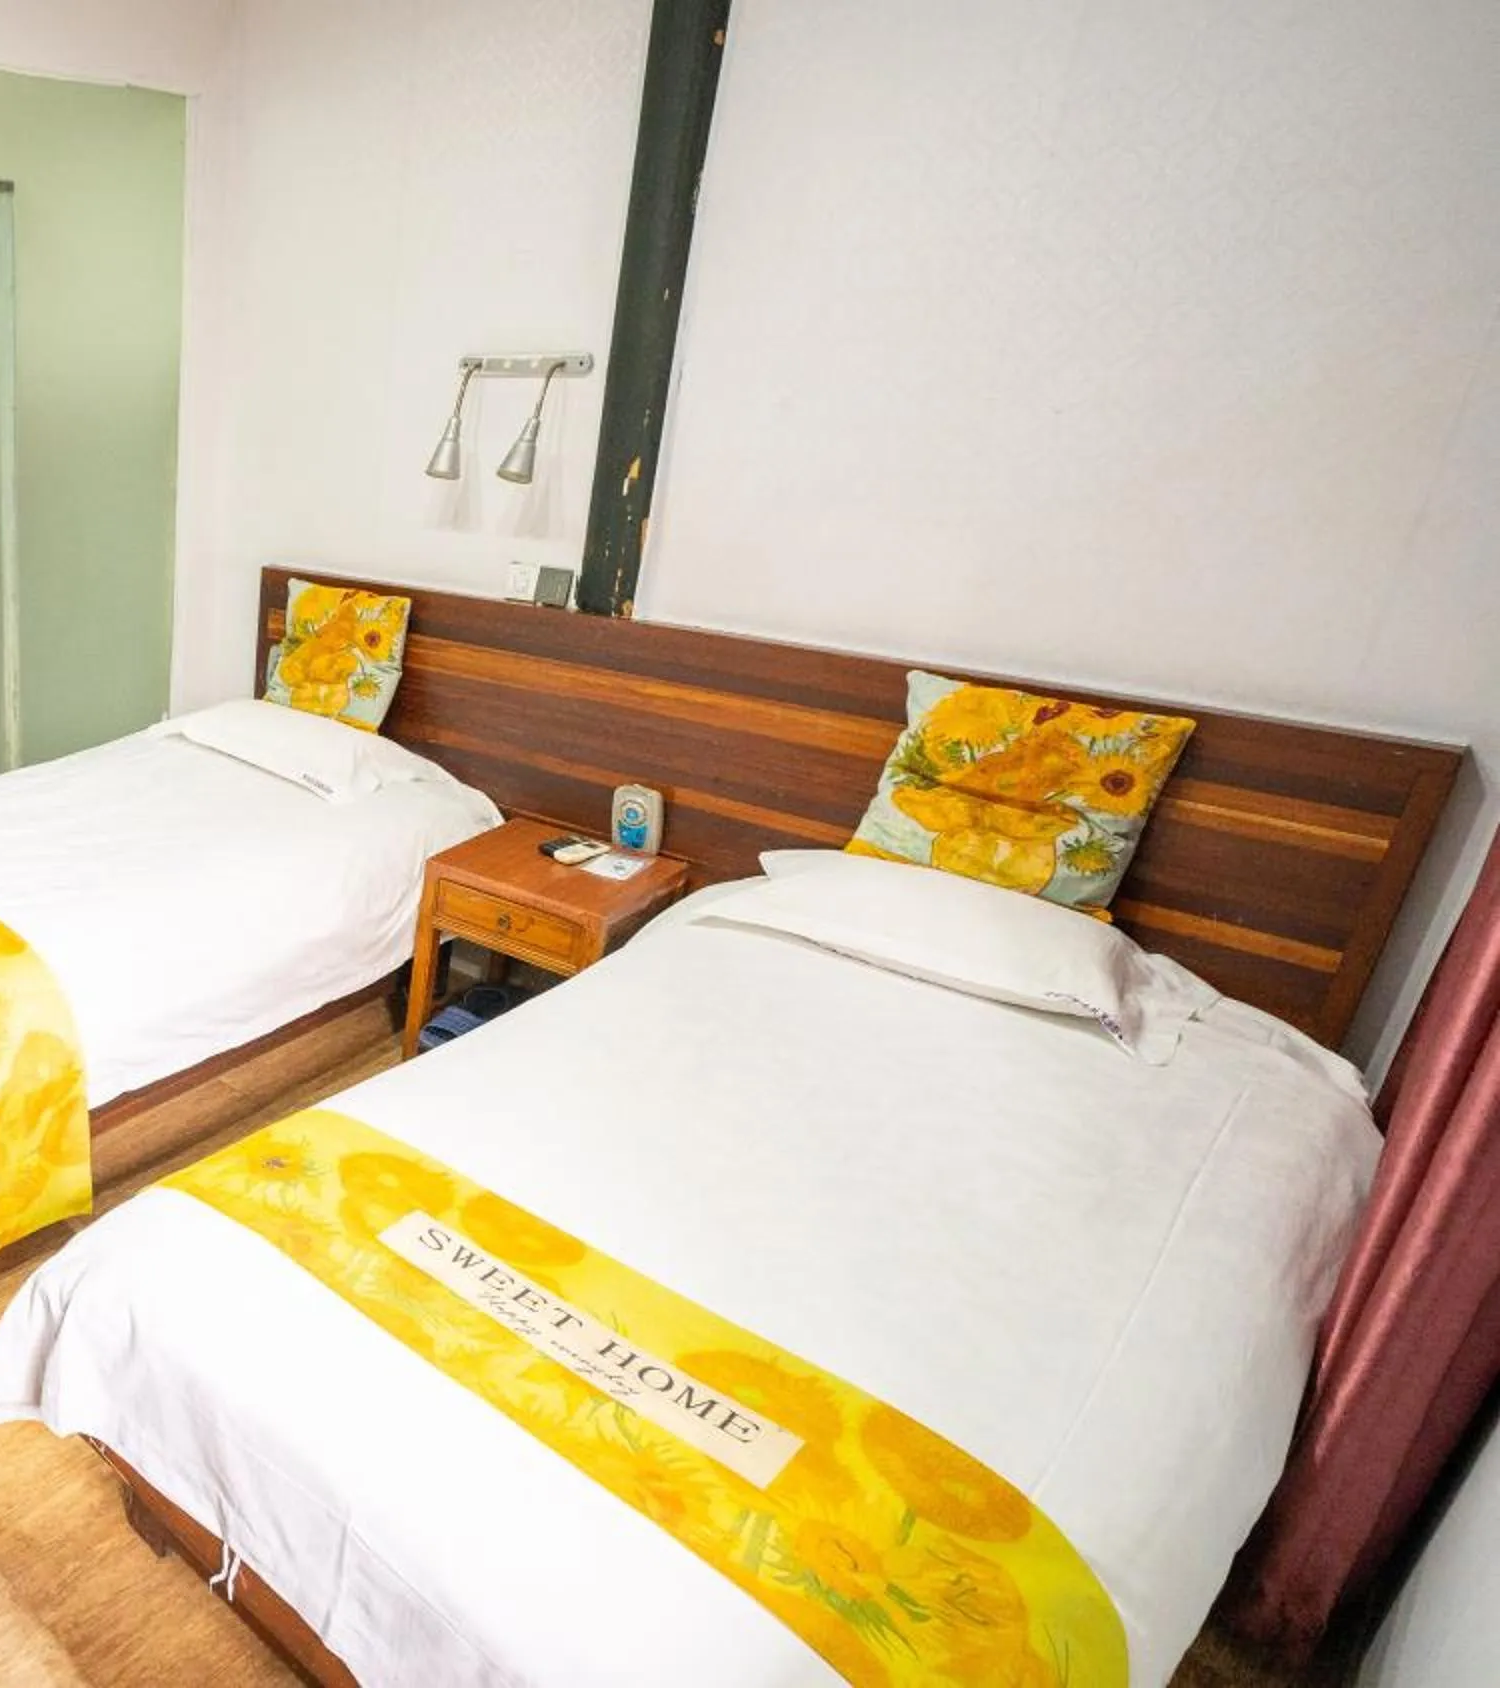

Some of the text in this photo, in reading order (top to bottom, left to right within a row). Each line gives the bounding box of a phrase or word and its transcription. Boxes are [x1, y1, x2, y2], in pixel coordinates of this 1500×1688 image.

[417, 1227, 761, 1444] SWEET HOME
[477, 1290, 542, 1336] Happy
